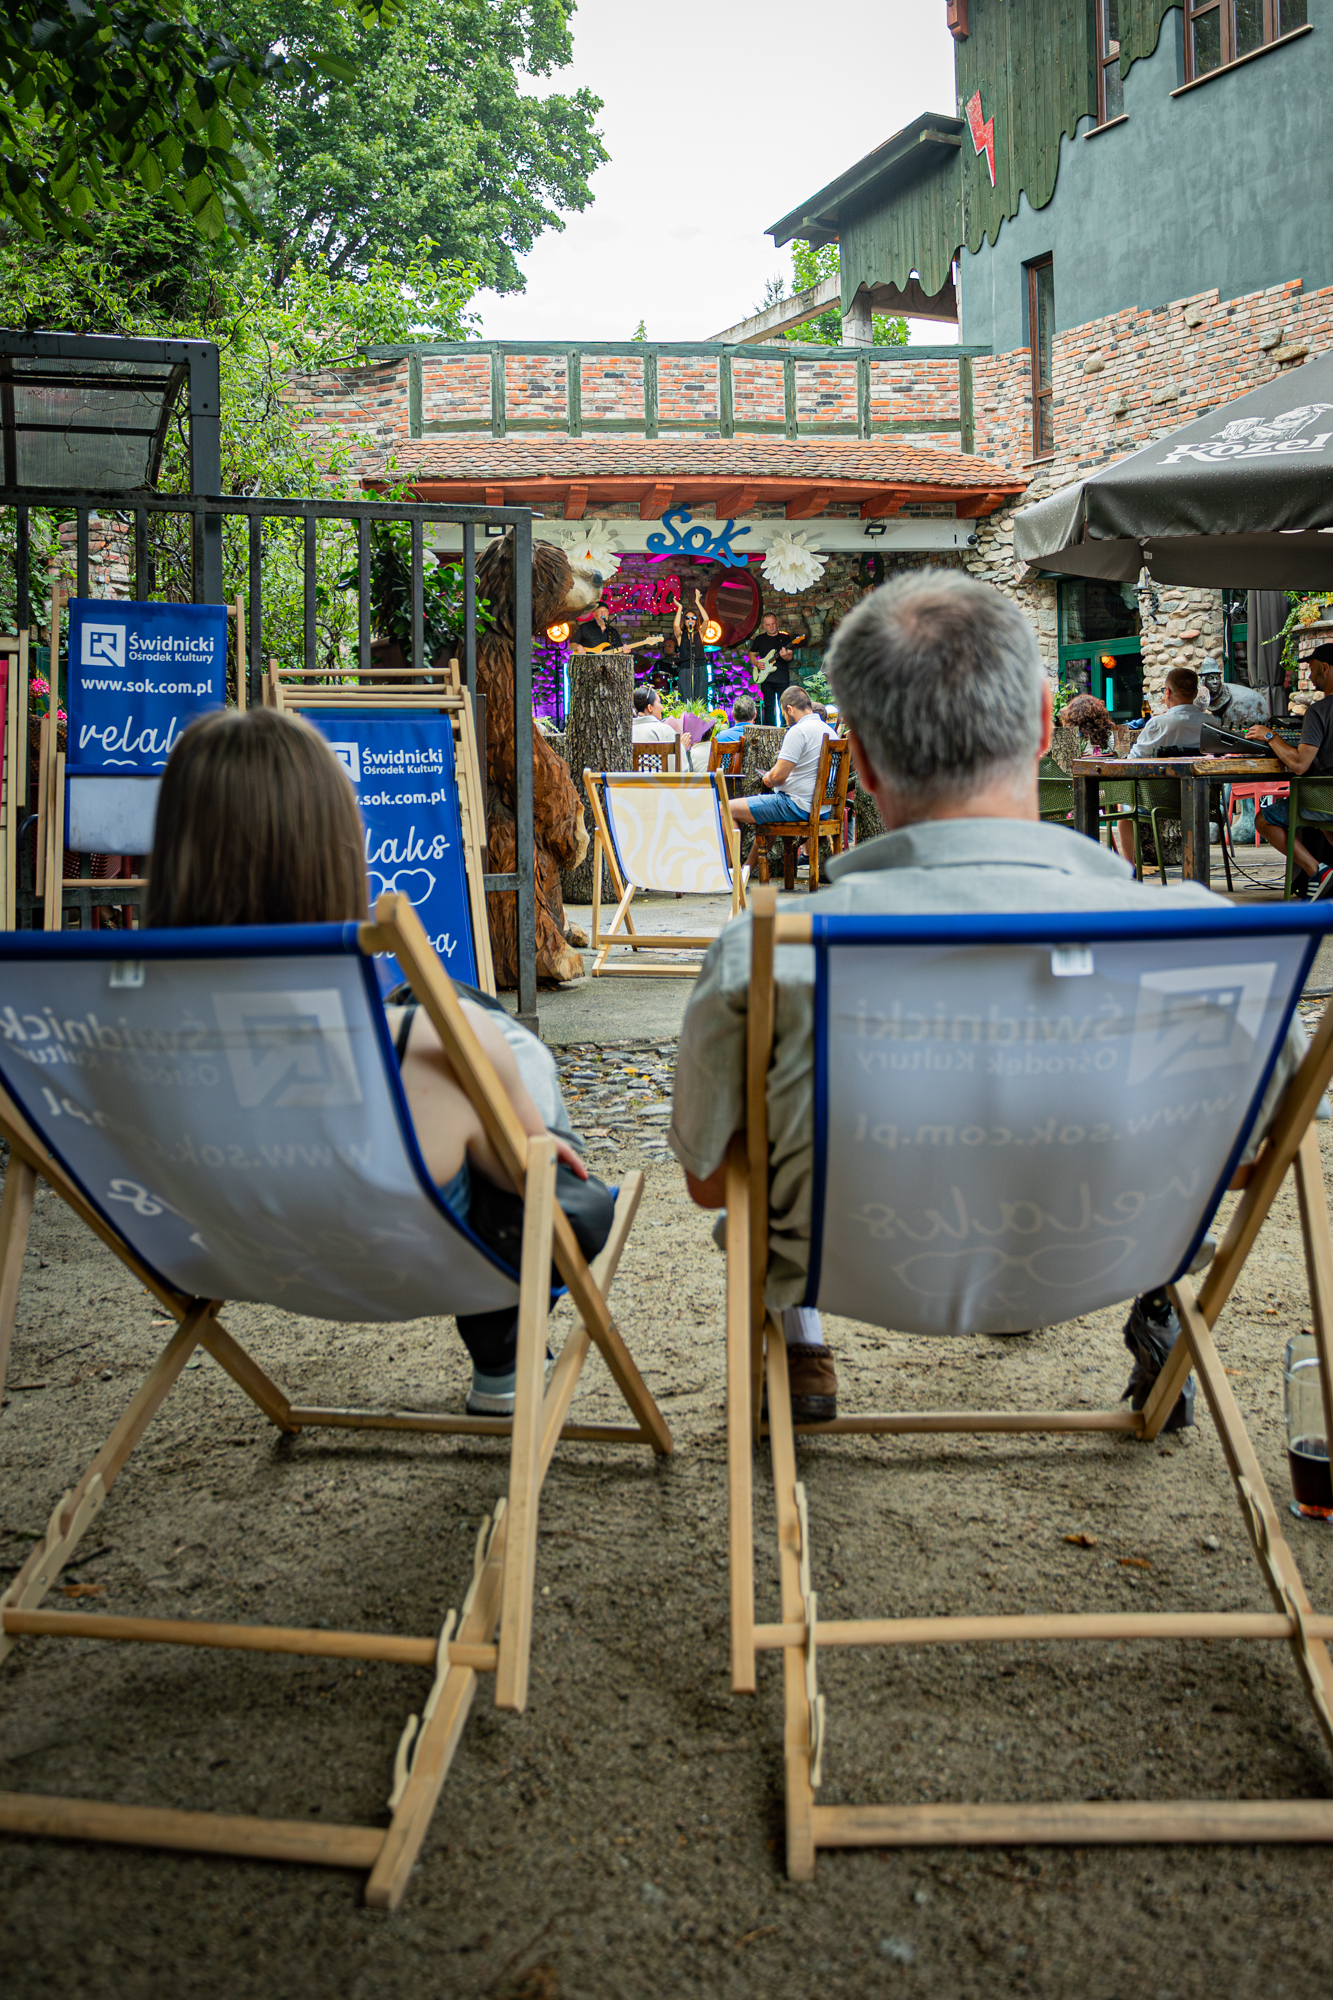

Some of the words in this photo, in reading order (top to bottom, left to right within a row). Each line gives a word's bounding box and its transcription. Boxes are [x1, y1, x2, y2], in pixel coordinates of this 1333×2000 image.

[1156, 432, 1333, 464] Kozel
[128, 632, 214, 652] Świdnicki
[129, 651, 172, 662] Ośrodek
[175, 653, 214, 664] Kultury
[81, 678, 213, 696] www.sok.com.pl
[362, 747, 443, 765] Świdnicki
[363, 765, 405, 775] Ośrodek
[407, 764, 443, 775] Kultury
